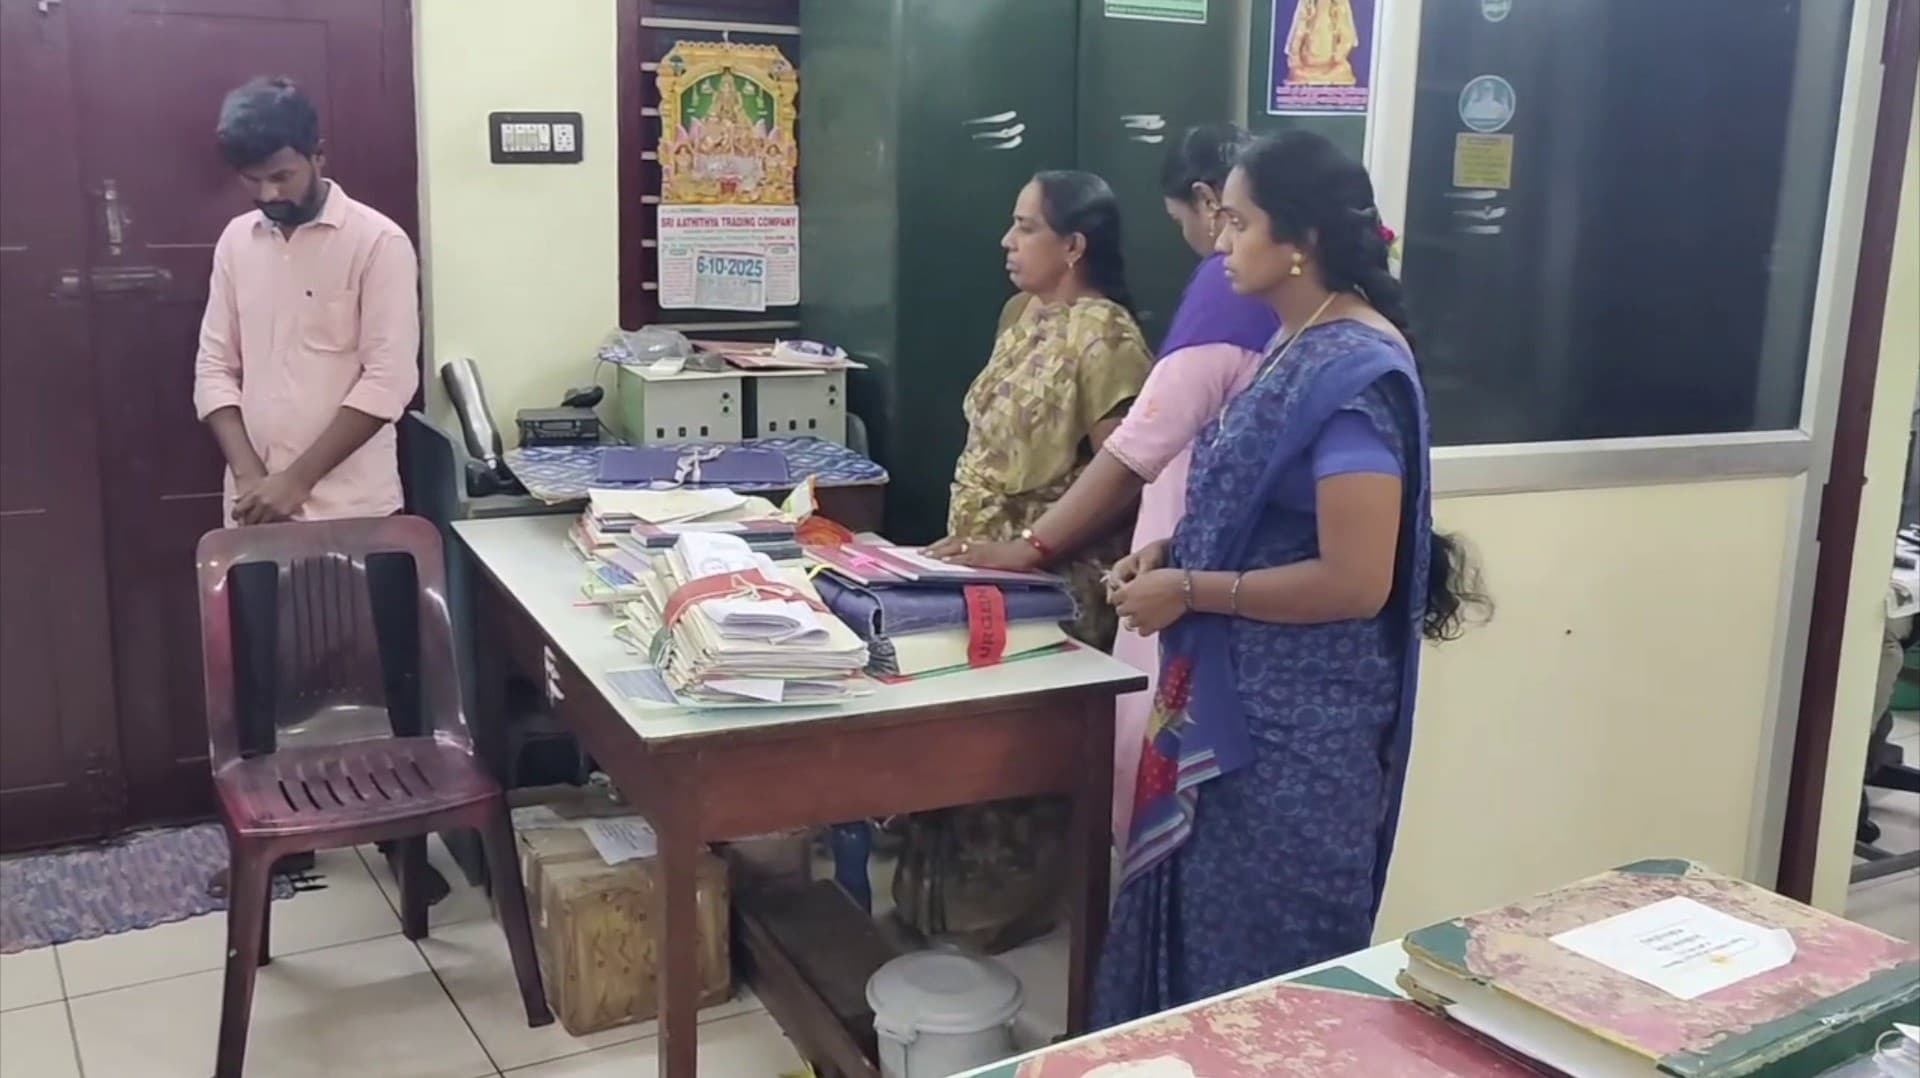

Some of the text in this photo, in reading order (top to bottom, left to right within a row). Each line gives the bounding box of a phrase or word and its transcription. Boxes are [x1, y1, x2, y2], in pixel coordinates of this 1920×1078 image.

[661, 217, 674, 228] SRI
[721, 217, 756, 227] TRADING
[757, 217, 796, 227] COMPANY
[697, 256, 763, 277] 6-10-2025
